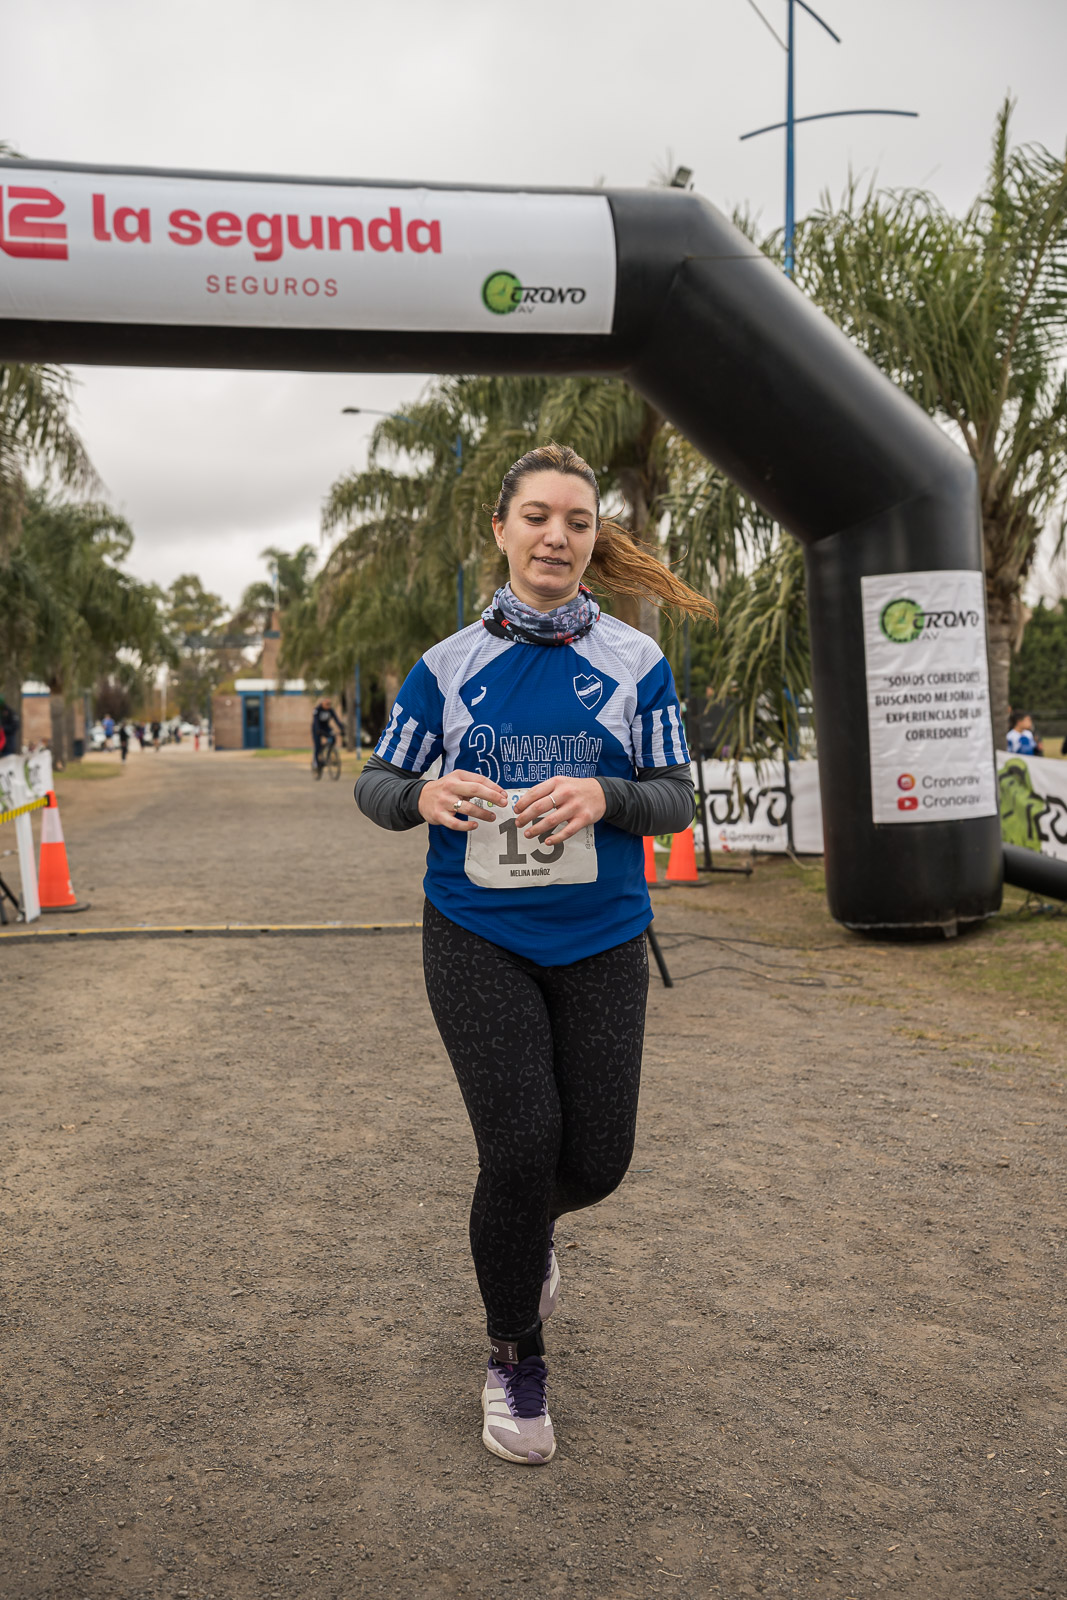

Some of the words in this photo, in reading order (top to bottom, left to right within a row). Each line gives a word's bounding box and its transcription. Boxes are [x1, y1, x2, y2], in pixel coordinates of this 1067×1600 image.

[92, 193, 151, 244] la
[167, 206, 443, 262] segunda
[205, 274, 340, 298] SEGUROS
[875, 692, 932, 707] BUSCANDO
[886, 709, 958, 724] EXPERIENCIAS
[499, 730, 603, 763] MARATÓN
[922, 774, 981, 790] Cronorav
[922, 793, 982, 809] Cronorav
[531, 867, 551, 877] MUÑOZ
